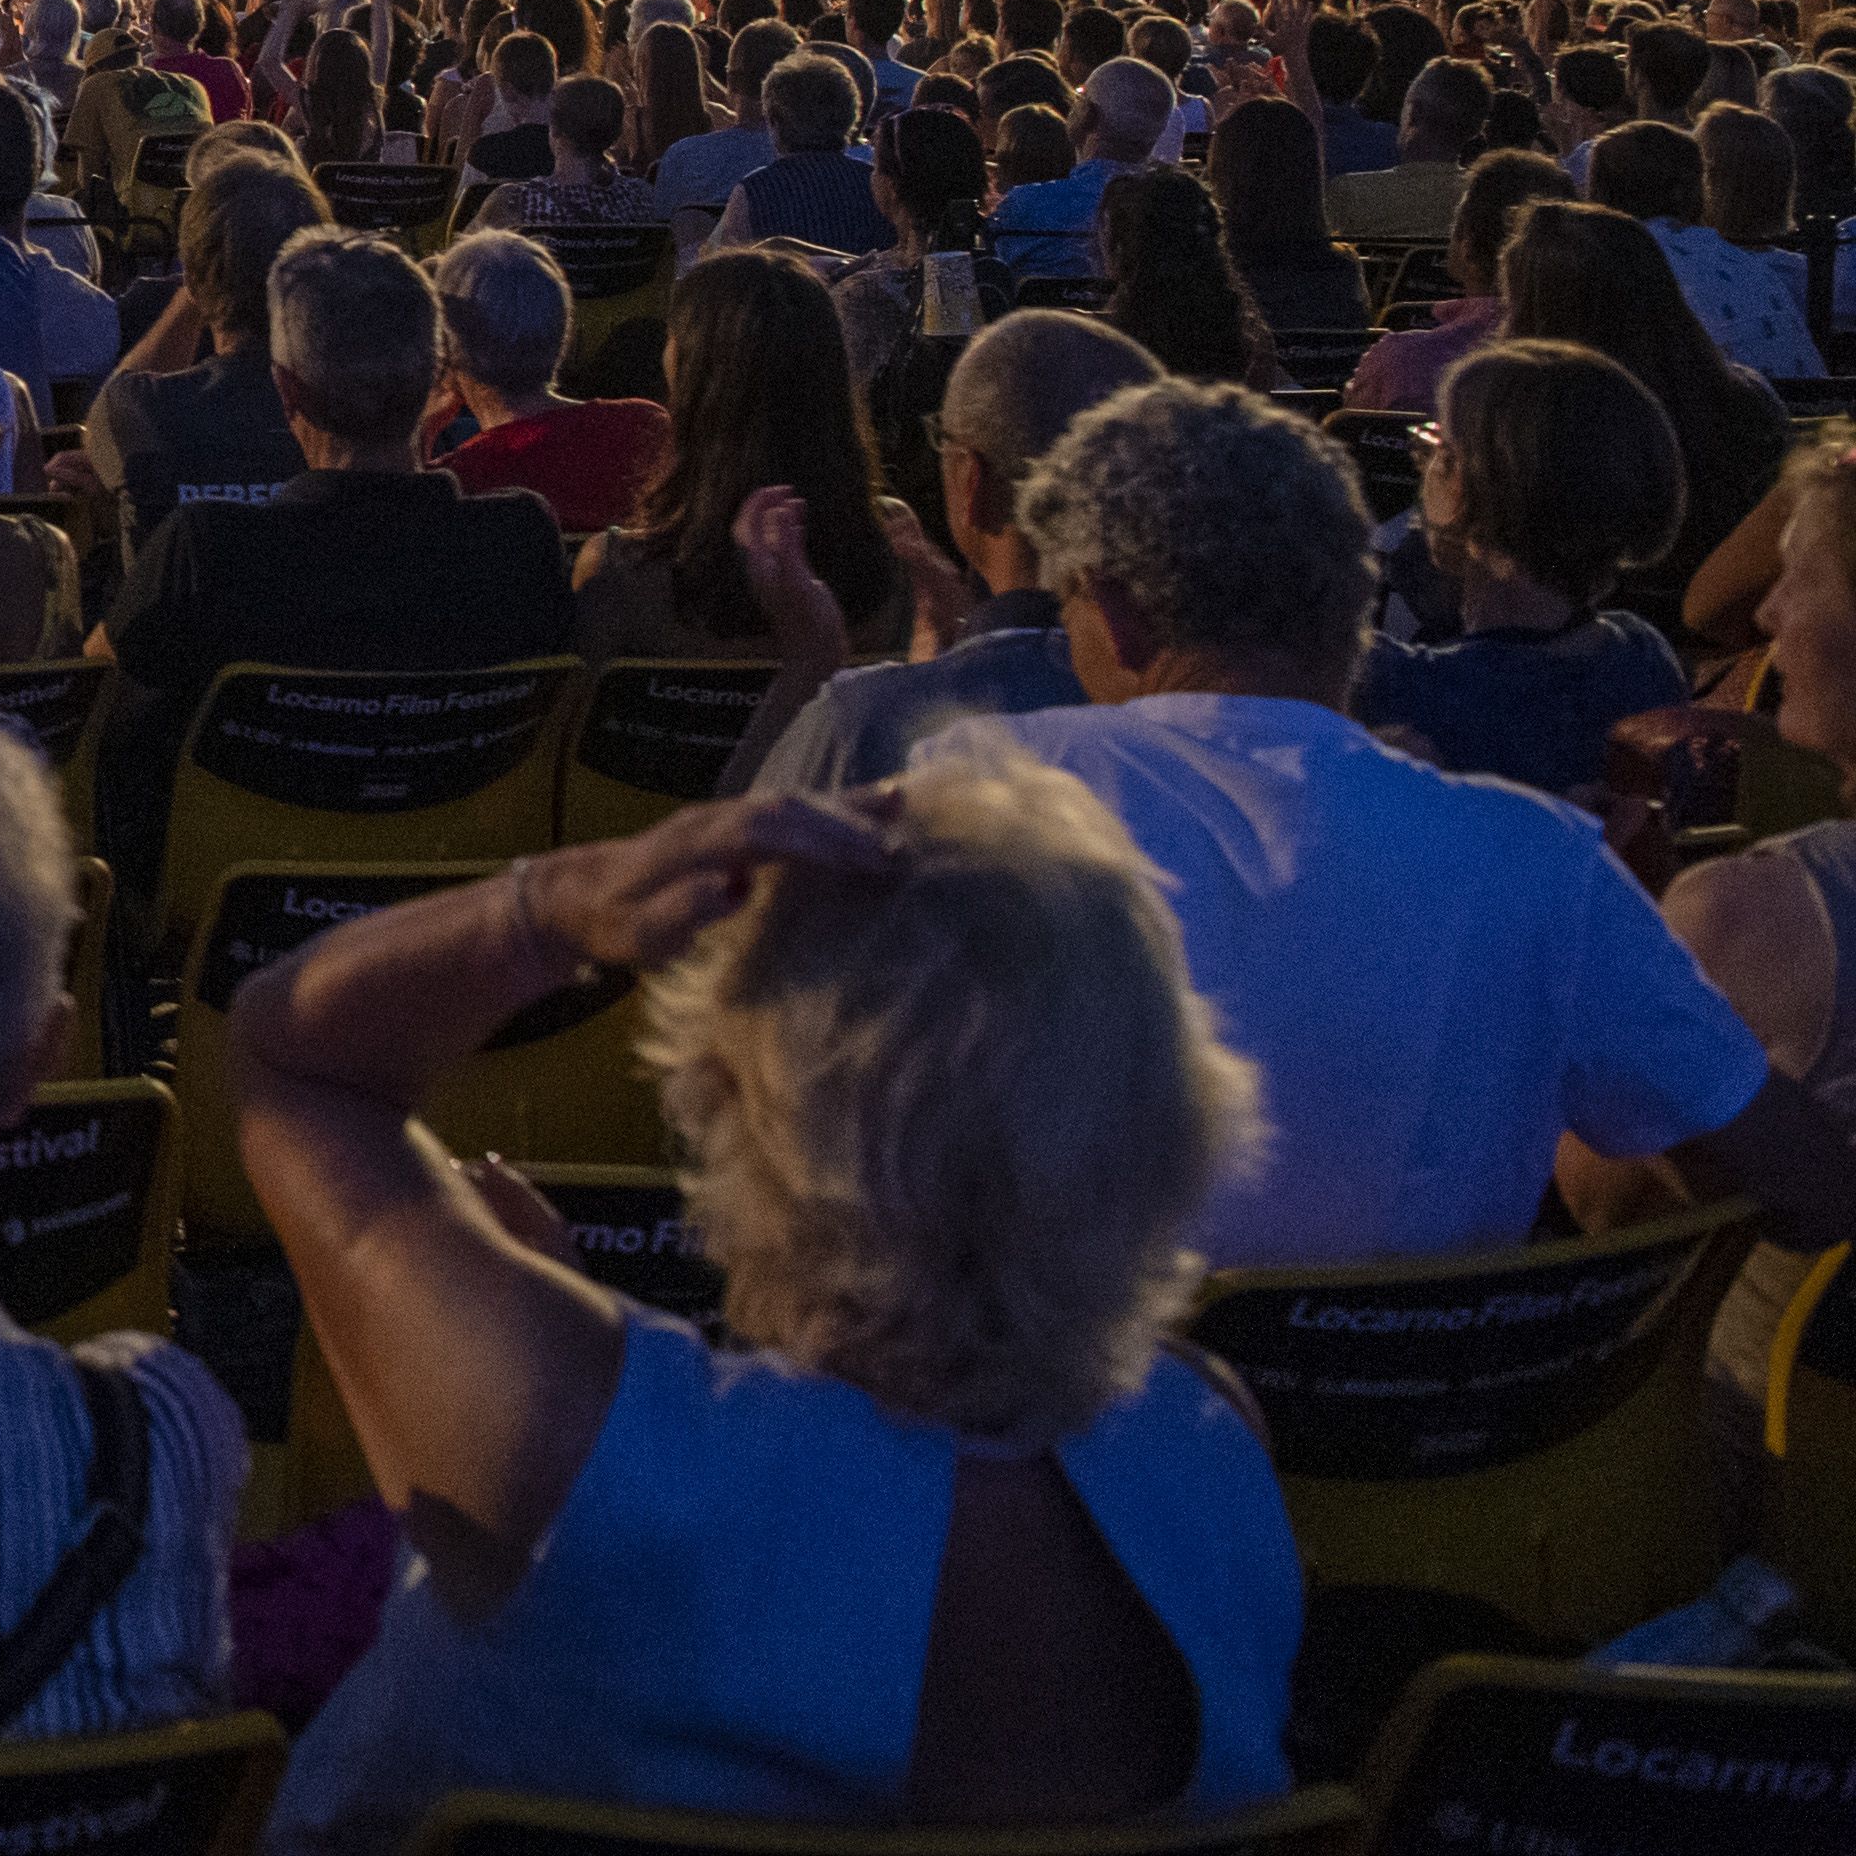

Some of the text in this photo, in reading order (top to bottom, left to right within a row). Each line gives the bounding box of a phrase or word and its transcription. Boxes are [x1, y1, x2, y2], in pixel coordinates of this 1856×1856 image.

[266, 677, 538, 716] Locarno Film Festival
[648, 677, 763, 707] Locarno
[1288, 1297, 1474, 1332] Locarno
[1476, 1293, 1565, 1326] Film
[1550, 1717, 1834, 1801] Locarno
